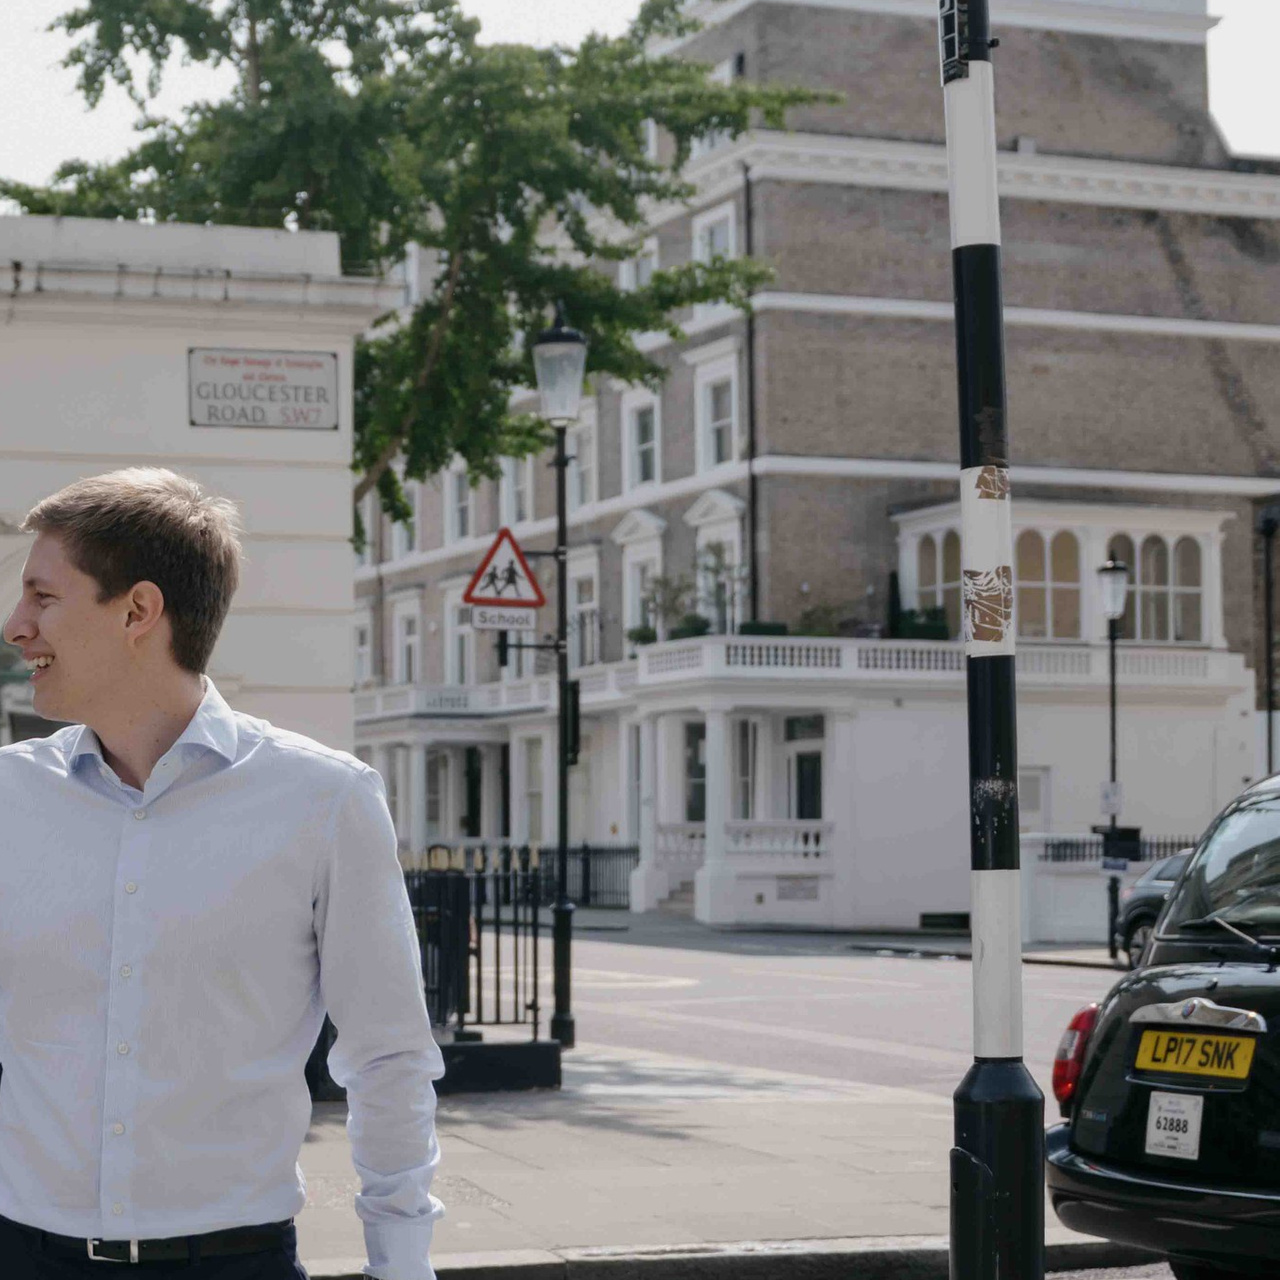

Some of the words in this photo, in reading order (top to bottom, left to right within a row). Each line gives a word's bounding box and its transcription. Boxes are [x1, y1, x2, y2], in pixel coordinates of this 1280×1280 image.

[196, 383, 329, 404] GLOUCESTER
[207, 405, 265, 423] ROAD
[478, 610, 530, 625] School
[1151, 1035, 1196, 1065] LP17
[1198, 1040, 1240, 1070] SNK
[1155, 1116, 1189, 1134] 62888
